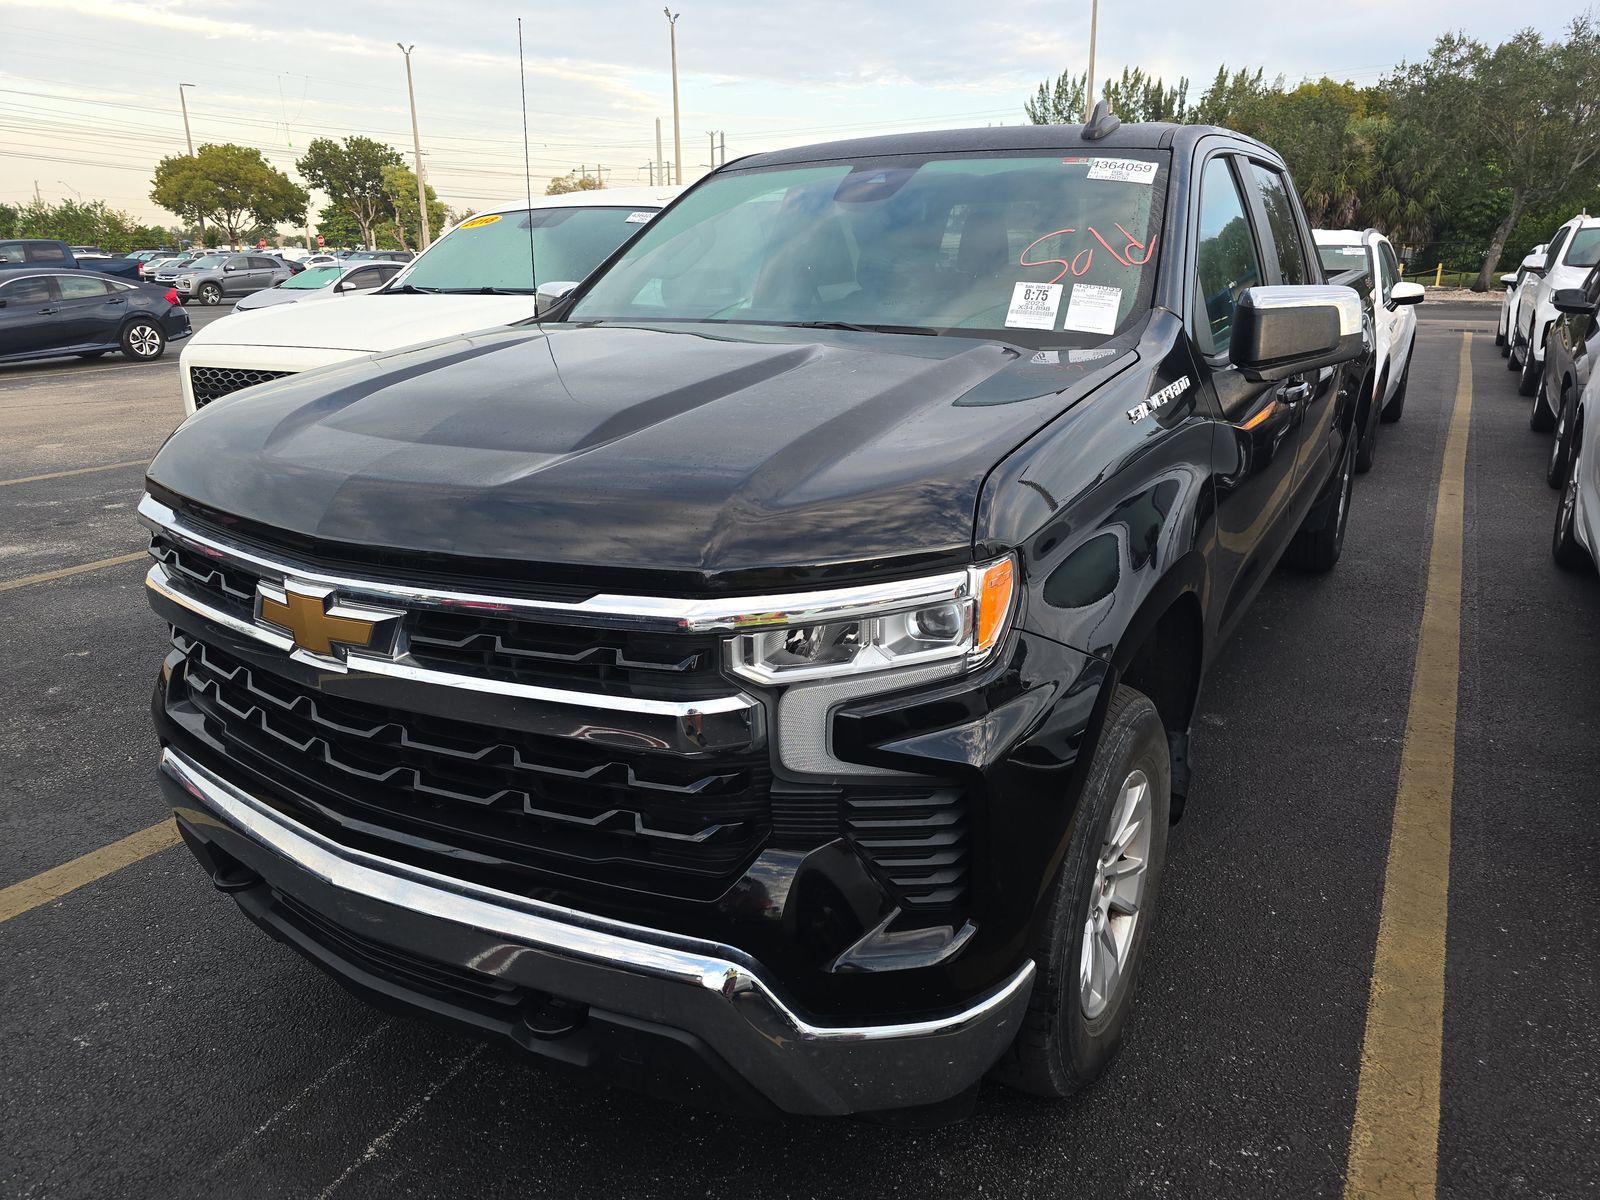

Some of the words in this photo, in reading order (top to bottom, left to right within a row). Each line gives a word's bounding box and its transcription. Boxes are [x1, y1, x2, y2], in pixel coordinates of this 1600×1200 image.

[1093, 160, 1152, 173] 4364059
[1020, 222, 1157, 284] Sold
[1024, 289, 1049, 301] 8:75
